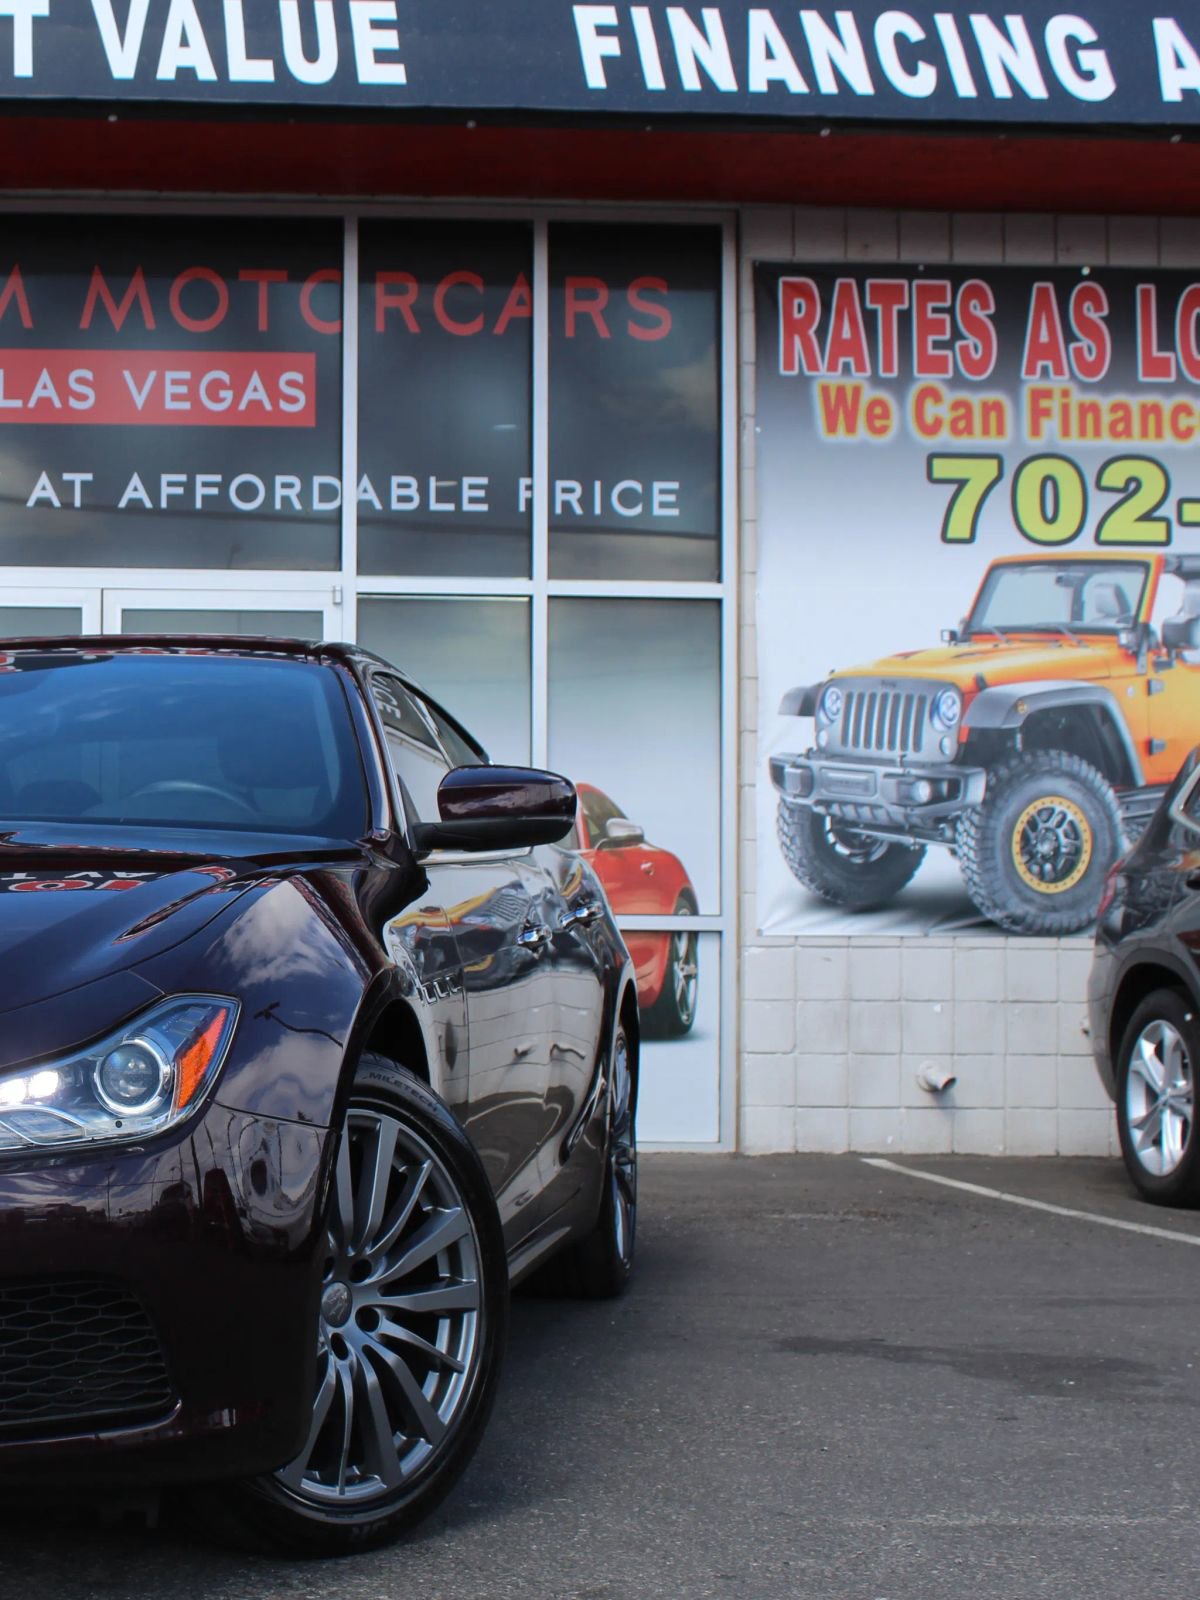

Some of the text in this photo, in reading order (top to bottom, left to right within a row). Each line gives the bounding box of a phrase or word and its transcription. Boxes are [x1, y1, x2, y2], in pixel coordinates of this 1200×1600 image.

[91, 0, 407, 85] VALUE
[571, 5, 1116, 102] FINANCING
[78, 265, 674, 342] MOTORCARS
[778, 276, 997, 380] RATES
[1020, 281, 1112, 382] AS
[122, 369, 307, 413] VEGAS
[818, 382, 1200, 441] We Can Financ
[26, 472, 94, 508] AT
[117, 472, 490, 513] AFFORDABLE
